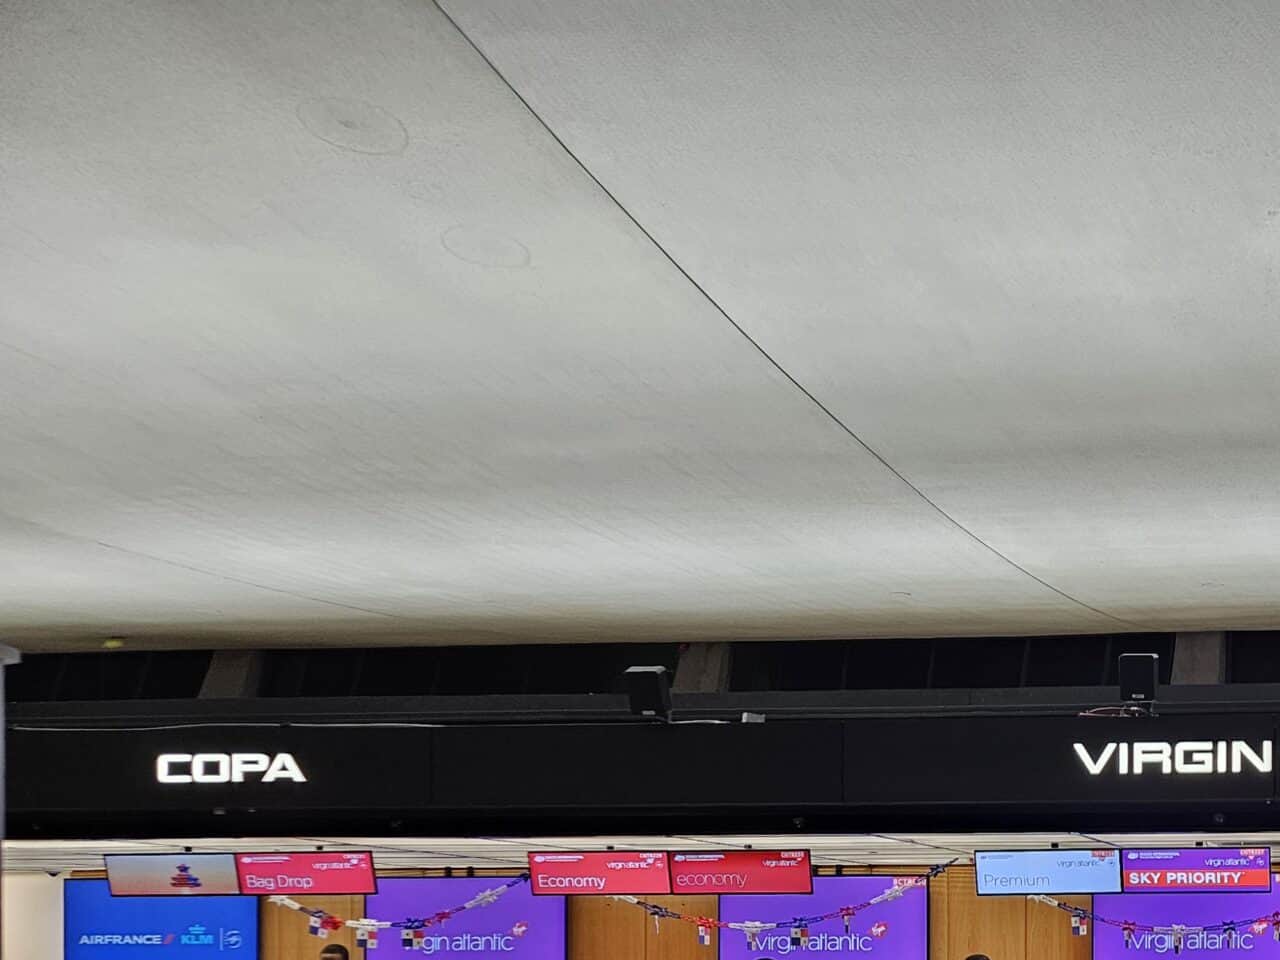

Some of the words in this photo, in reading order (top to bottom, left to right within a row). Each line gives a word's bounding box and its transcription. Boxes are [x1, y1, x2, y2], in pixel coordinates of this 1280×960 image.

[1073, 740, 1273, 775] VIRGIN
[156, 753, 308, 783] COPA
[247, 875, 275, 890] Bag
[278, 875, 313, 889] Drop
[538, 875, 606, 890] Economy
[677, 873, 748, 889] economy
[984, 873, 1050, 888] Premium
[1129, 872, 1161, 884] SKY
[1167, 871, 1241, 884] PRIORITY
[79, 935, 162, 945] AIRFRANCE
[181, 934, 215, 945] KLM
[451, 932, 514, 951] atlantic
[808, 933, 873, 952] atlantic
[1186, 931, 1254, 950] atlantic
